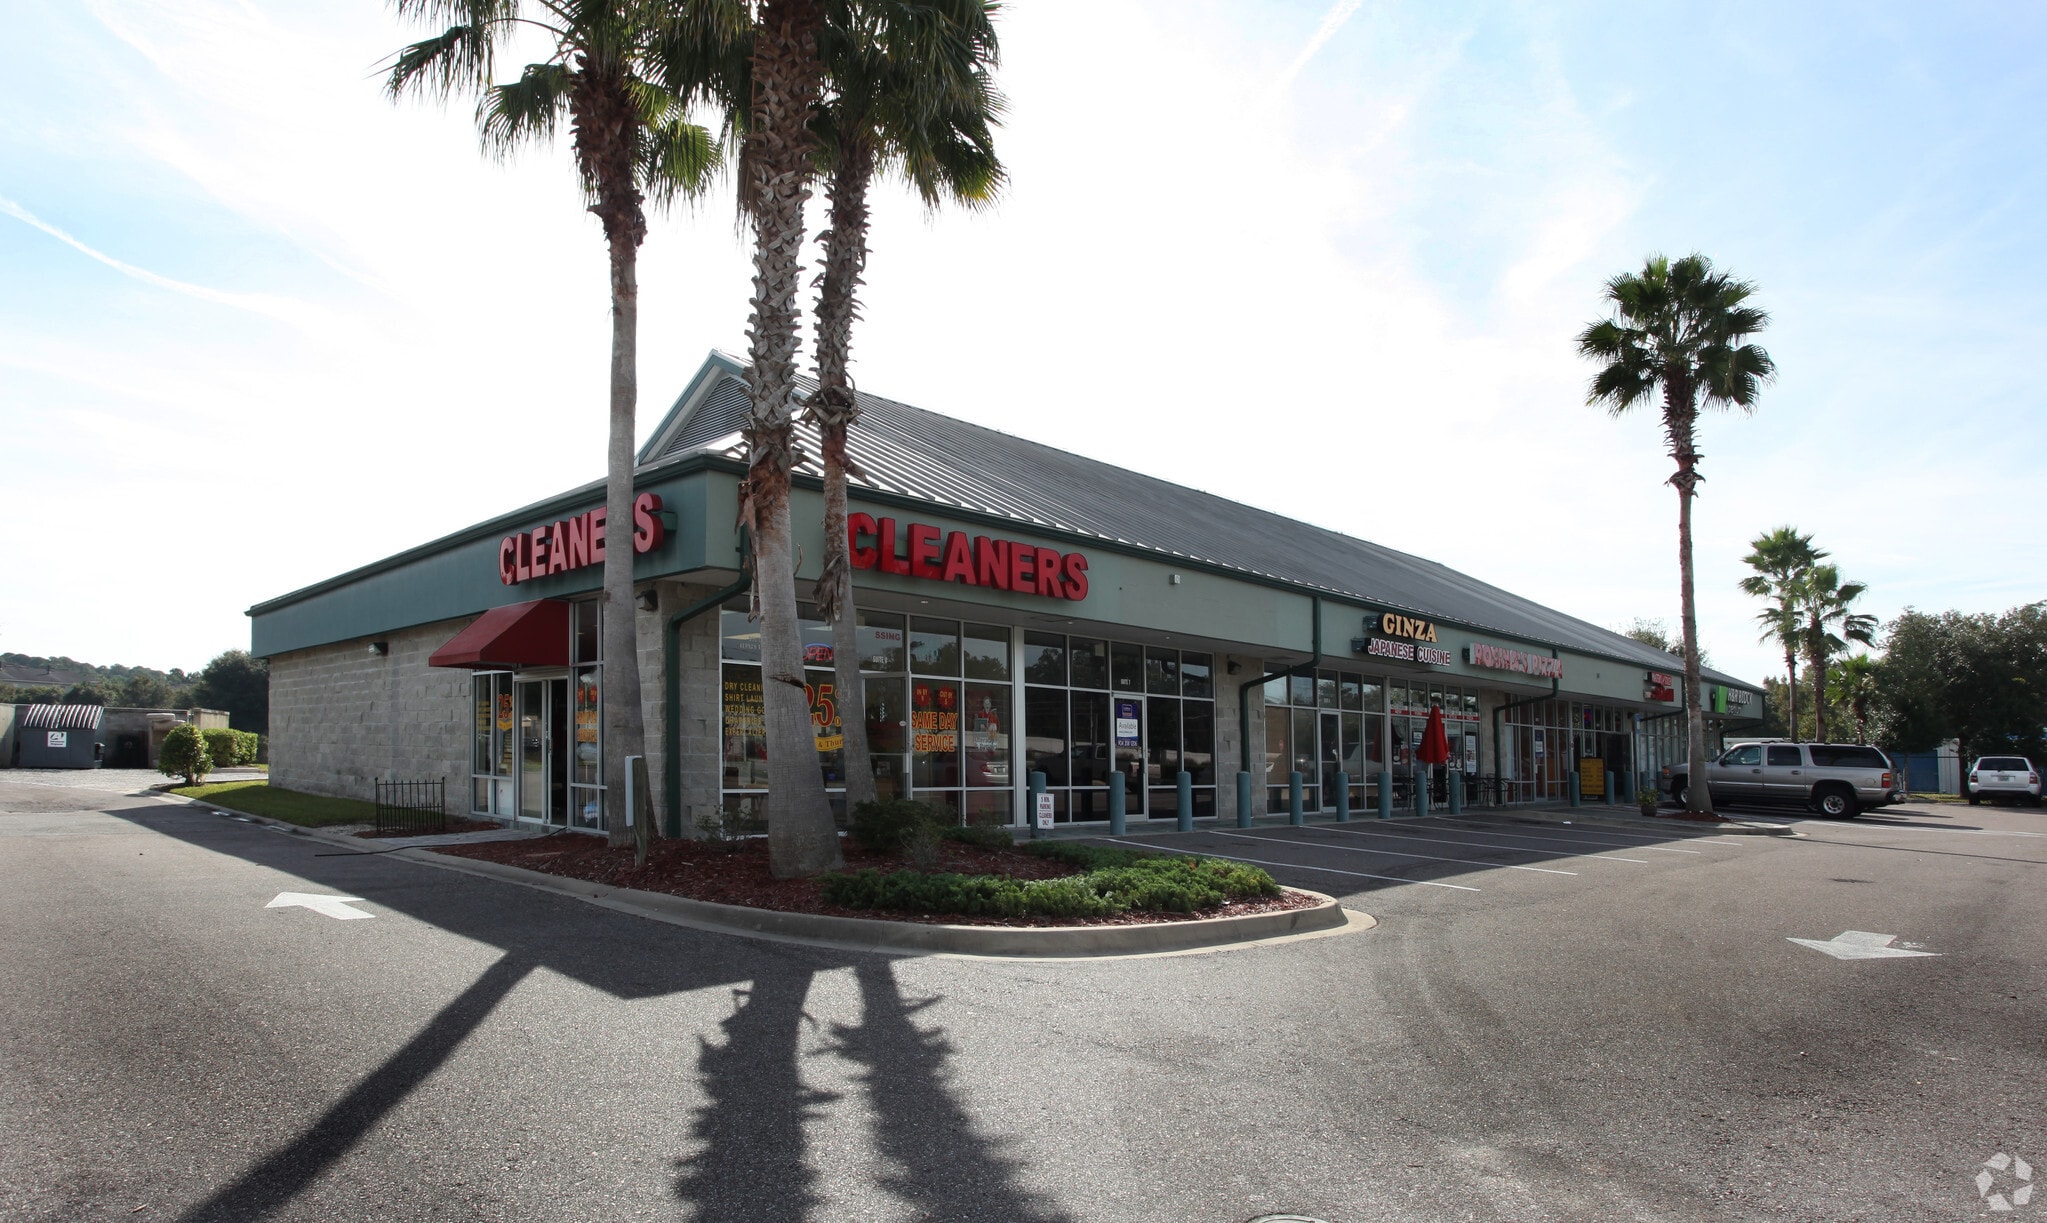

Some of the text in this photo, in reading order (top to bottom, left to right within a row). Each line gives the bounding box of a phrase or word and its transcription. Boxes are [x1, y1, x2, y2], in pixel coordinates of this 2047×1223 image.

[499, 492, 664, 586] CLEANES
[848, 512, 1089, 602] CLEANERS
[1383, 613, 1438, 642] GINZA
[1368, 638, 1451, 666] JAPANESE CUISINE
[725, 682, 763, 691] DRY CLEANI
[725, 693, 763, 703] SHIRT LAUN
[725, 704, 755, 714] WEDDING
[911, 711, 958, 730] SAME DAY
[1118, 721, 1137, 730] Available
[825, 739, 842, 748] Thur
[915, 734, 955, 752] SERVICE
